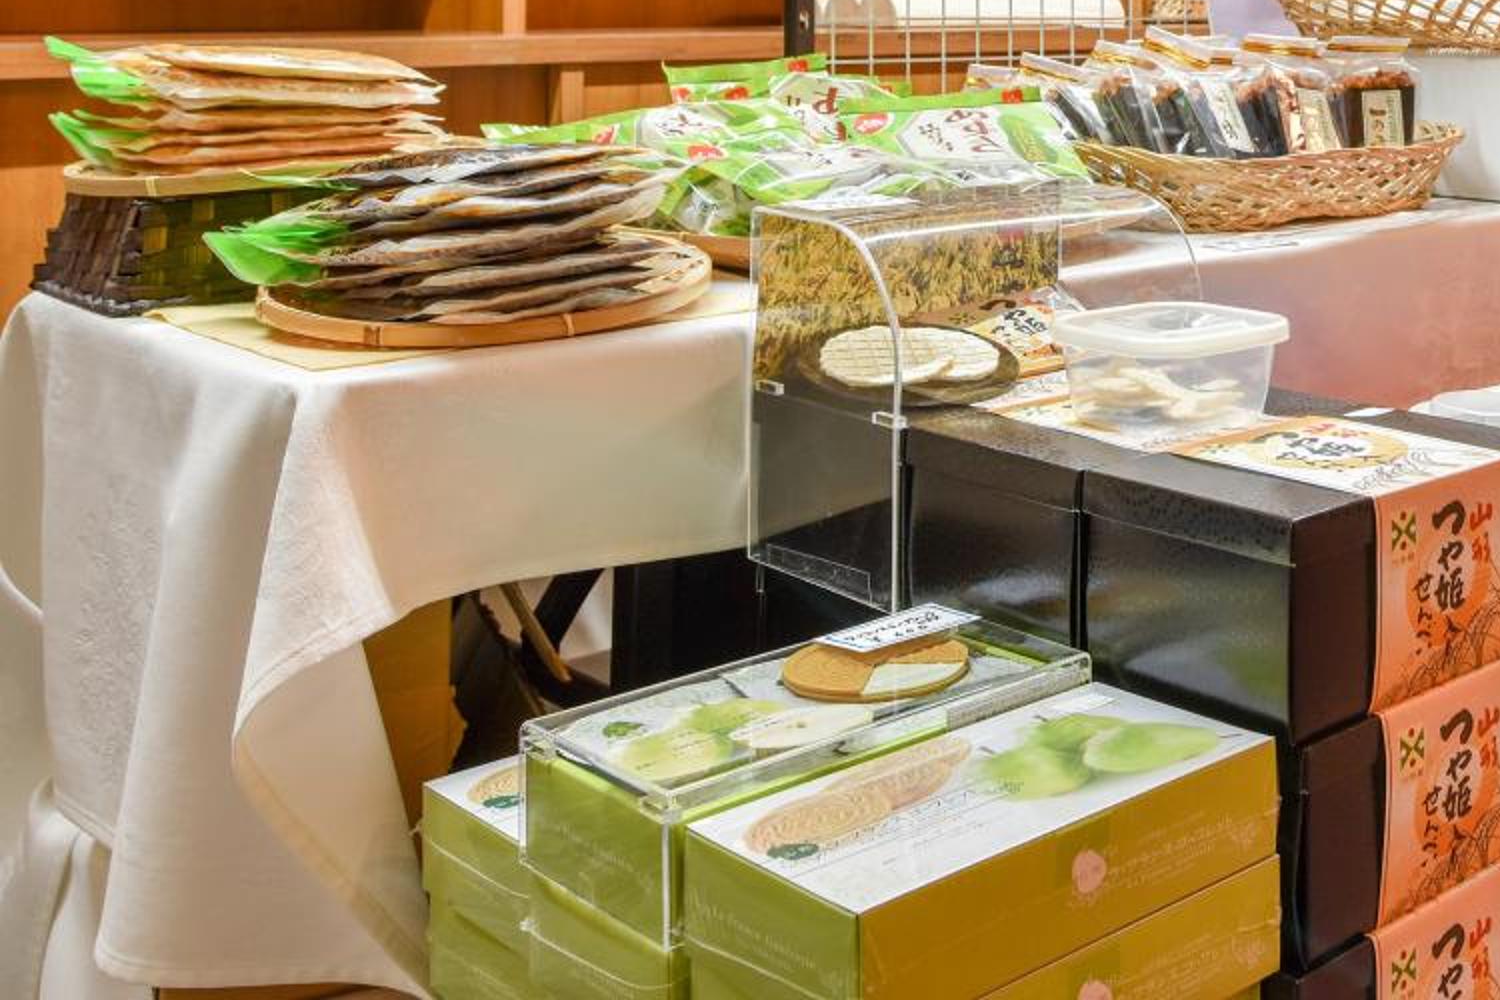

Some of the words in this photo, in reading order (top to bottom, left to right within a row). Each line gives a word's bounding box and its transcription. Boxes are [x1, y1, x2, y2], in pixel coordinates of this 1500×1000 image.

[1432, 500, 1466, 611] つや姫
[1440, 708, 1473, 822] つや姫
[1432, 923, 1465, 1000] つや
